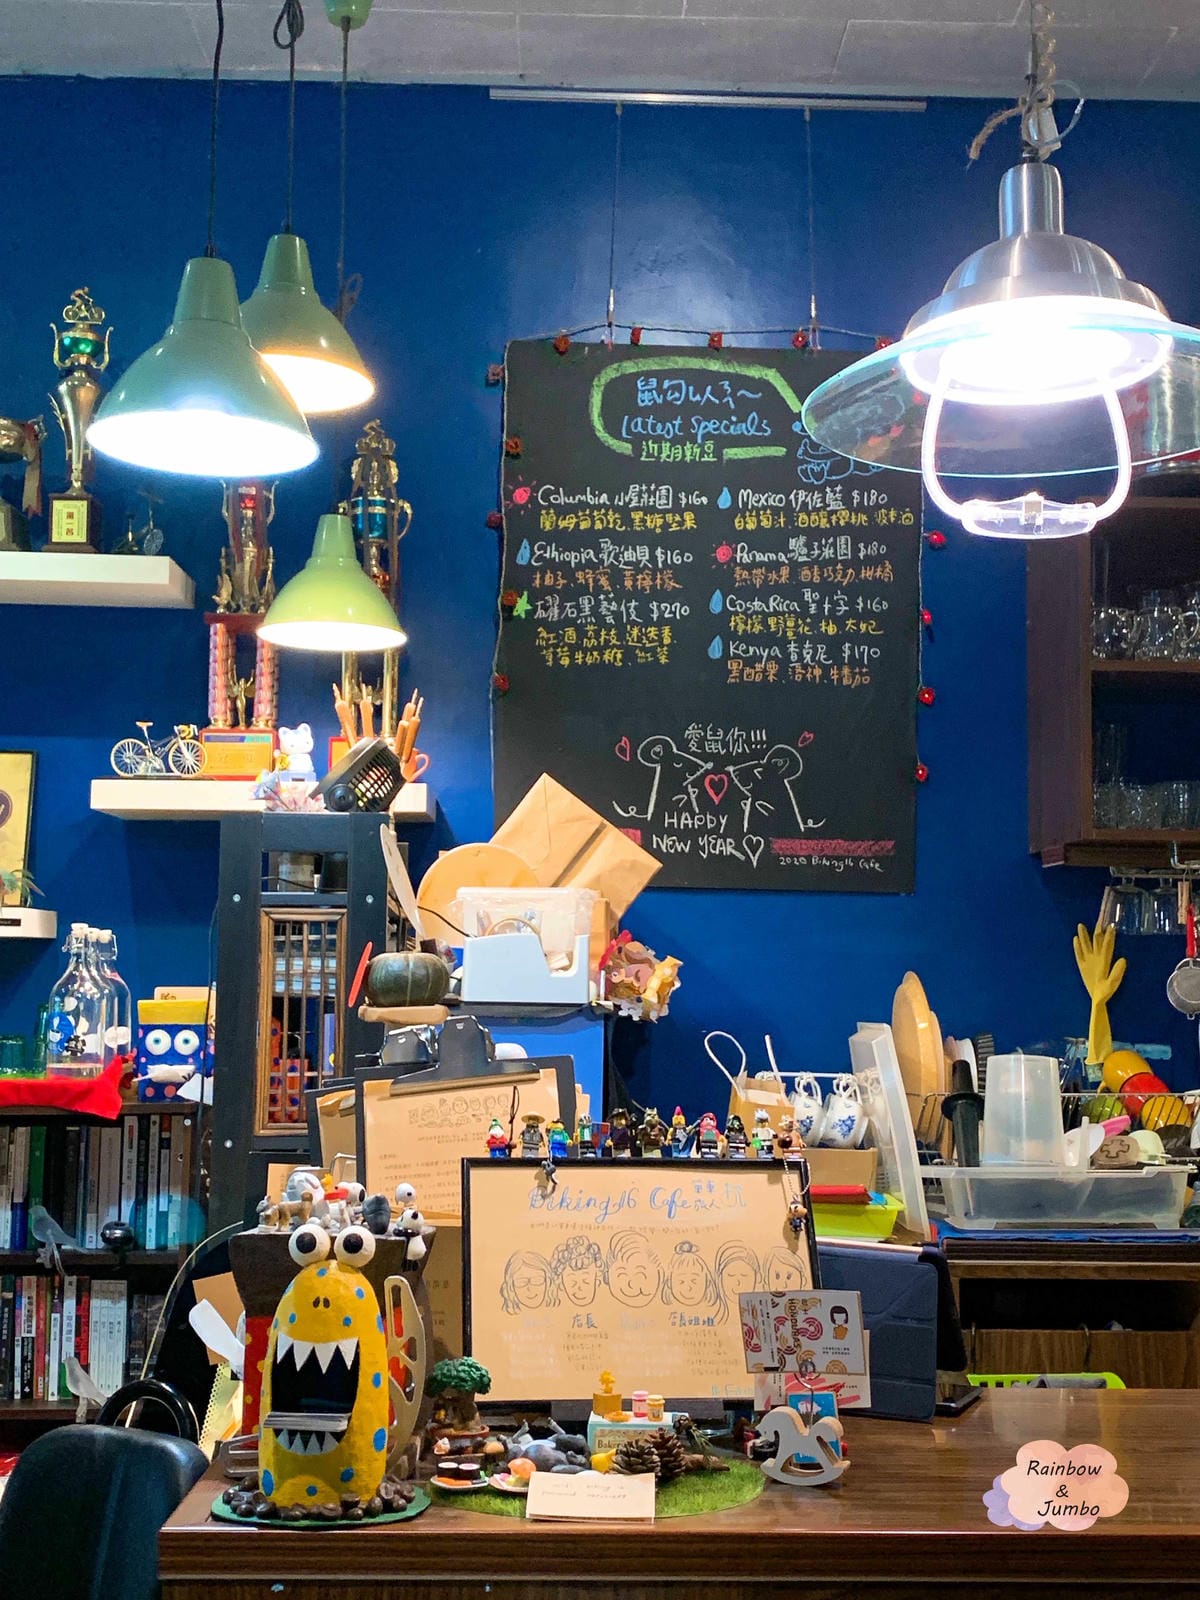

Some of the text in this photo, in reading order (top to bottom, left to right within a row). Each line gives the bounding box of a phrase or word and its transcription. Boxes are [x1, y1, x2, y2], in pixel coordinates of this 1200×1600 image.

[622, 415, 683, 439] Latest
[640, 440, 717, 462] 近期新豆
[537, 484, 610, 506] Columbia
[678, 491, 709, 508] $160
[738, 488, 786, 509] Mexico
[851, 488, 888, 507] $180
[531, 541, 599, 569] Ethiopia
[655, 546, 693, 568] $160
[736, 542, 789, 564] Panama
[858, 542, 887, 560] $180
[649, 602, 690, 623] $270
[801, 588, 850, 616] 聖十字
[855, 595, 889, 613] $160
[729, 640, 782, 666] Kenya
[841, 643, 881, 664] $170
[663, 811, 728, 833] HAPPY
[652, 834, 746, 861] NEW YEAR
[779, 856, 807, 867] 2020
[571, 1312, 598, 1329] 店長
